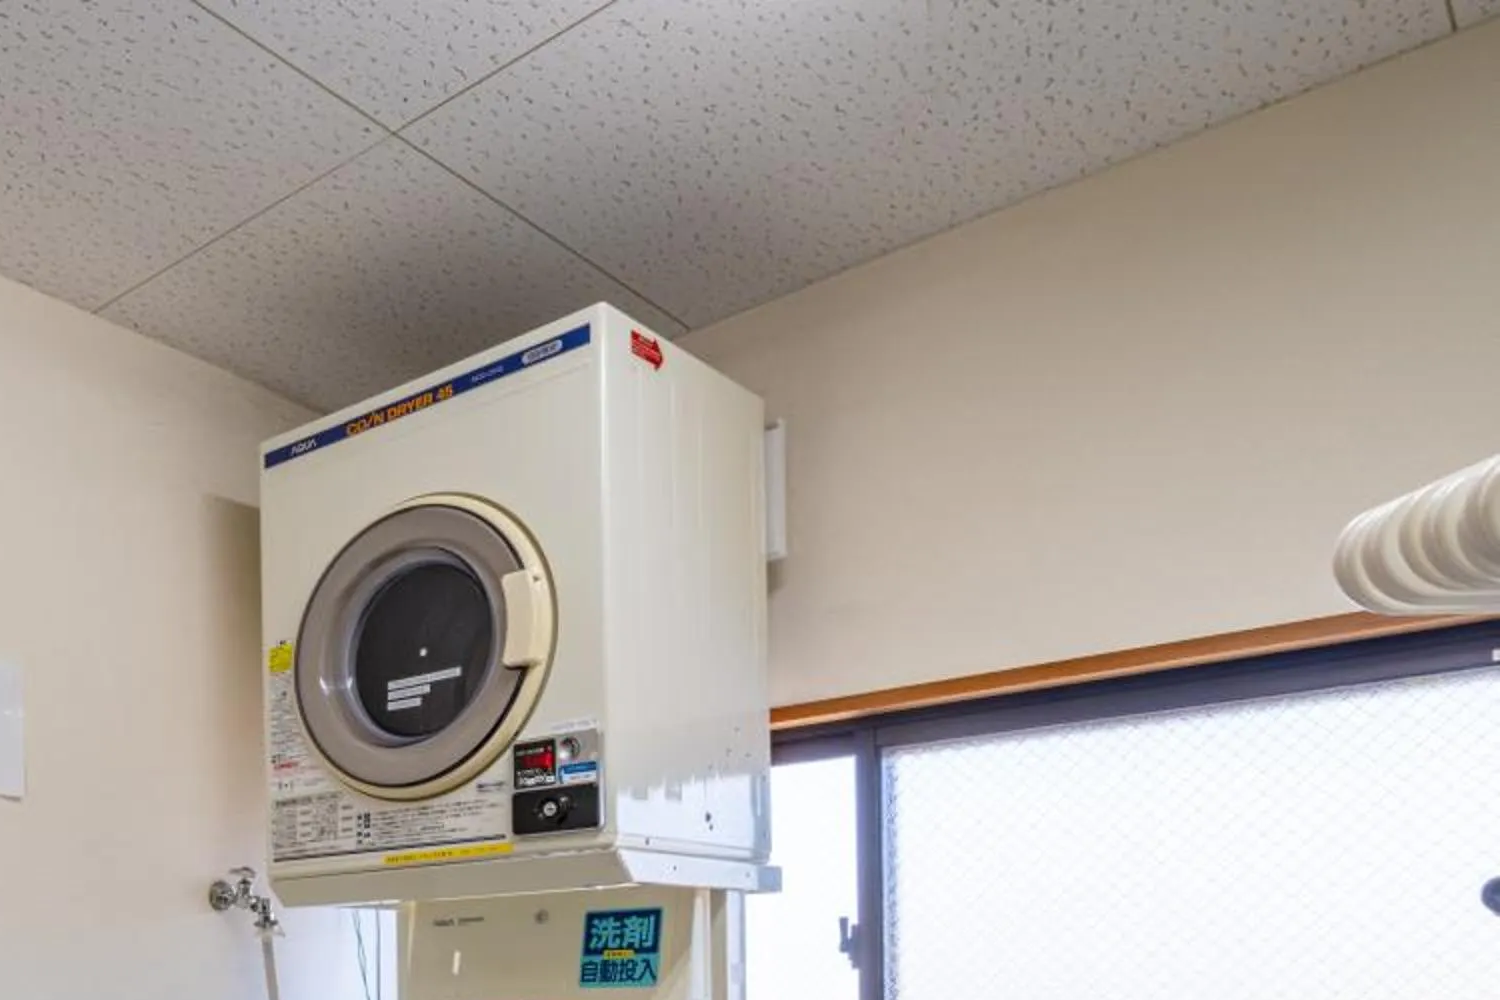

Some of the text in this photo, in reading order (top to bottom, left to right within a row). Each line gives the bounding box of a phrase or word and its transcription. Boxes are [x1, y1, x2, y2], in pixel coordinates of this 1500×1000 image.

[387, 391, 433, 419] DRYER
[589, 914, 656, 949] 洗剤
[580, 957, 658, 984] 自動投入
